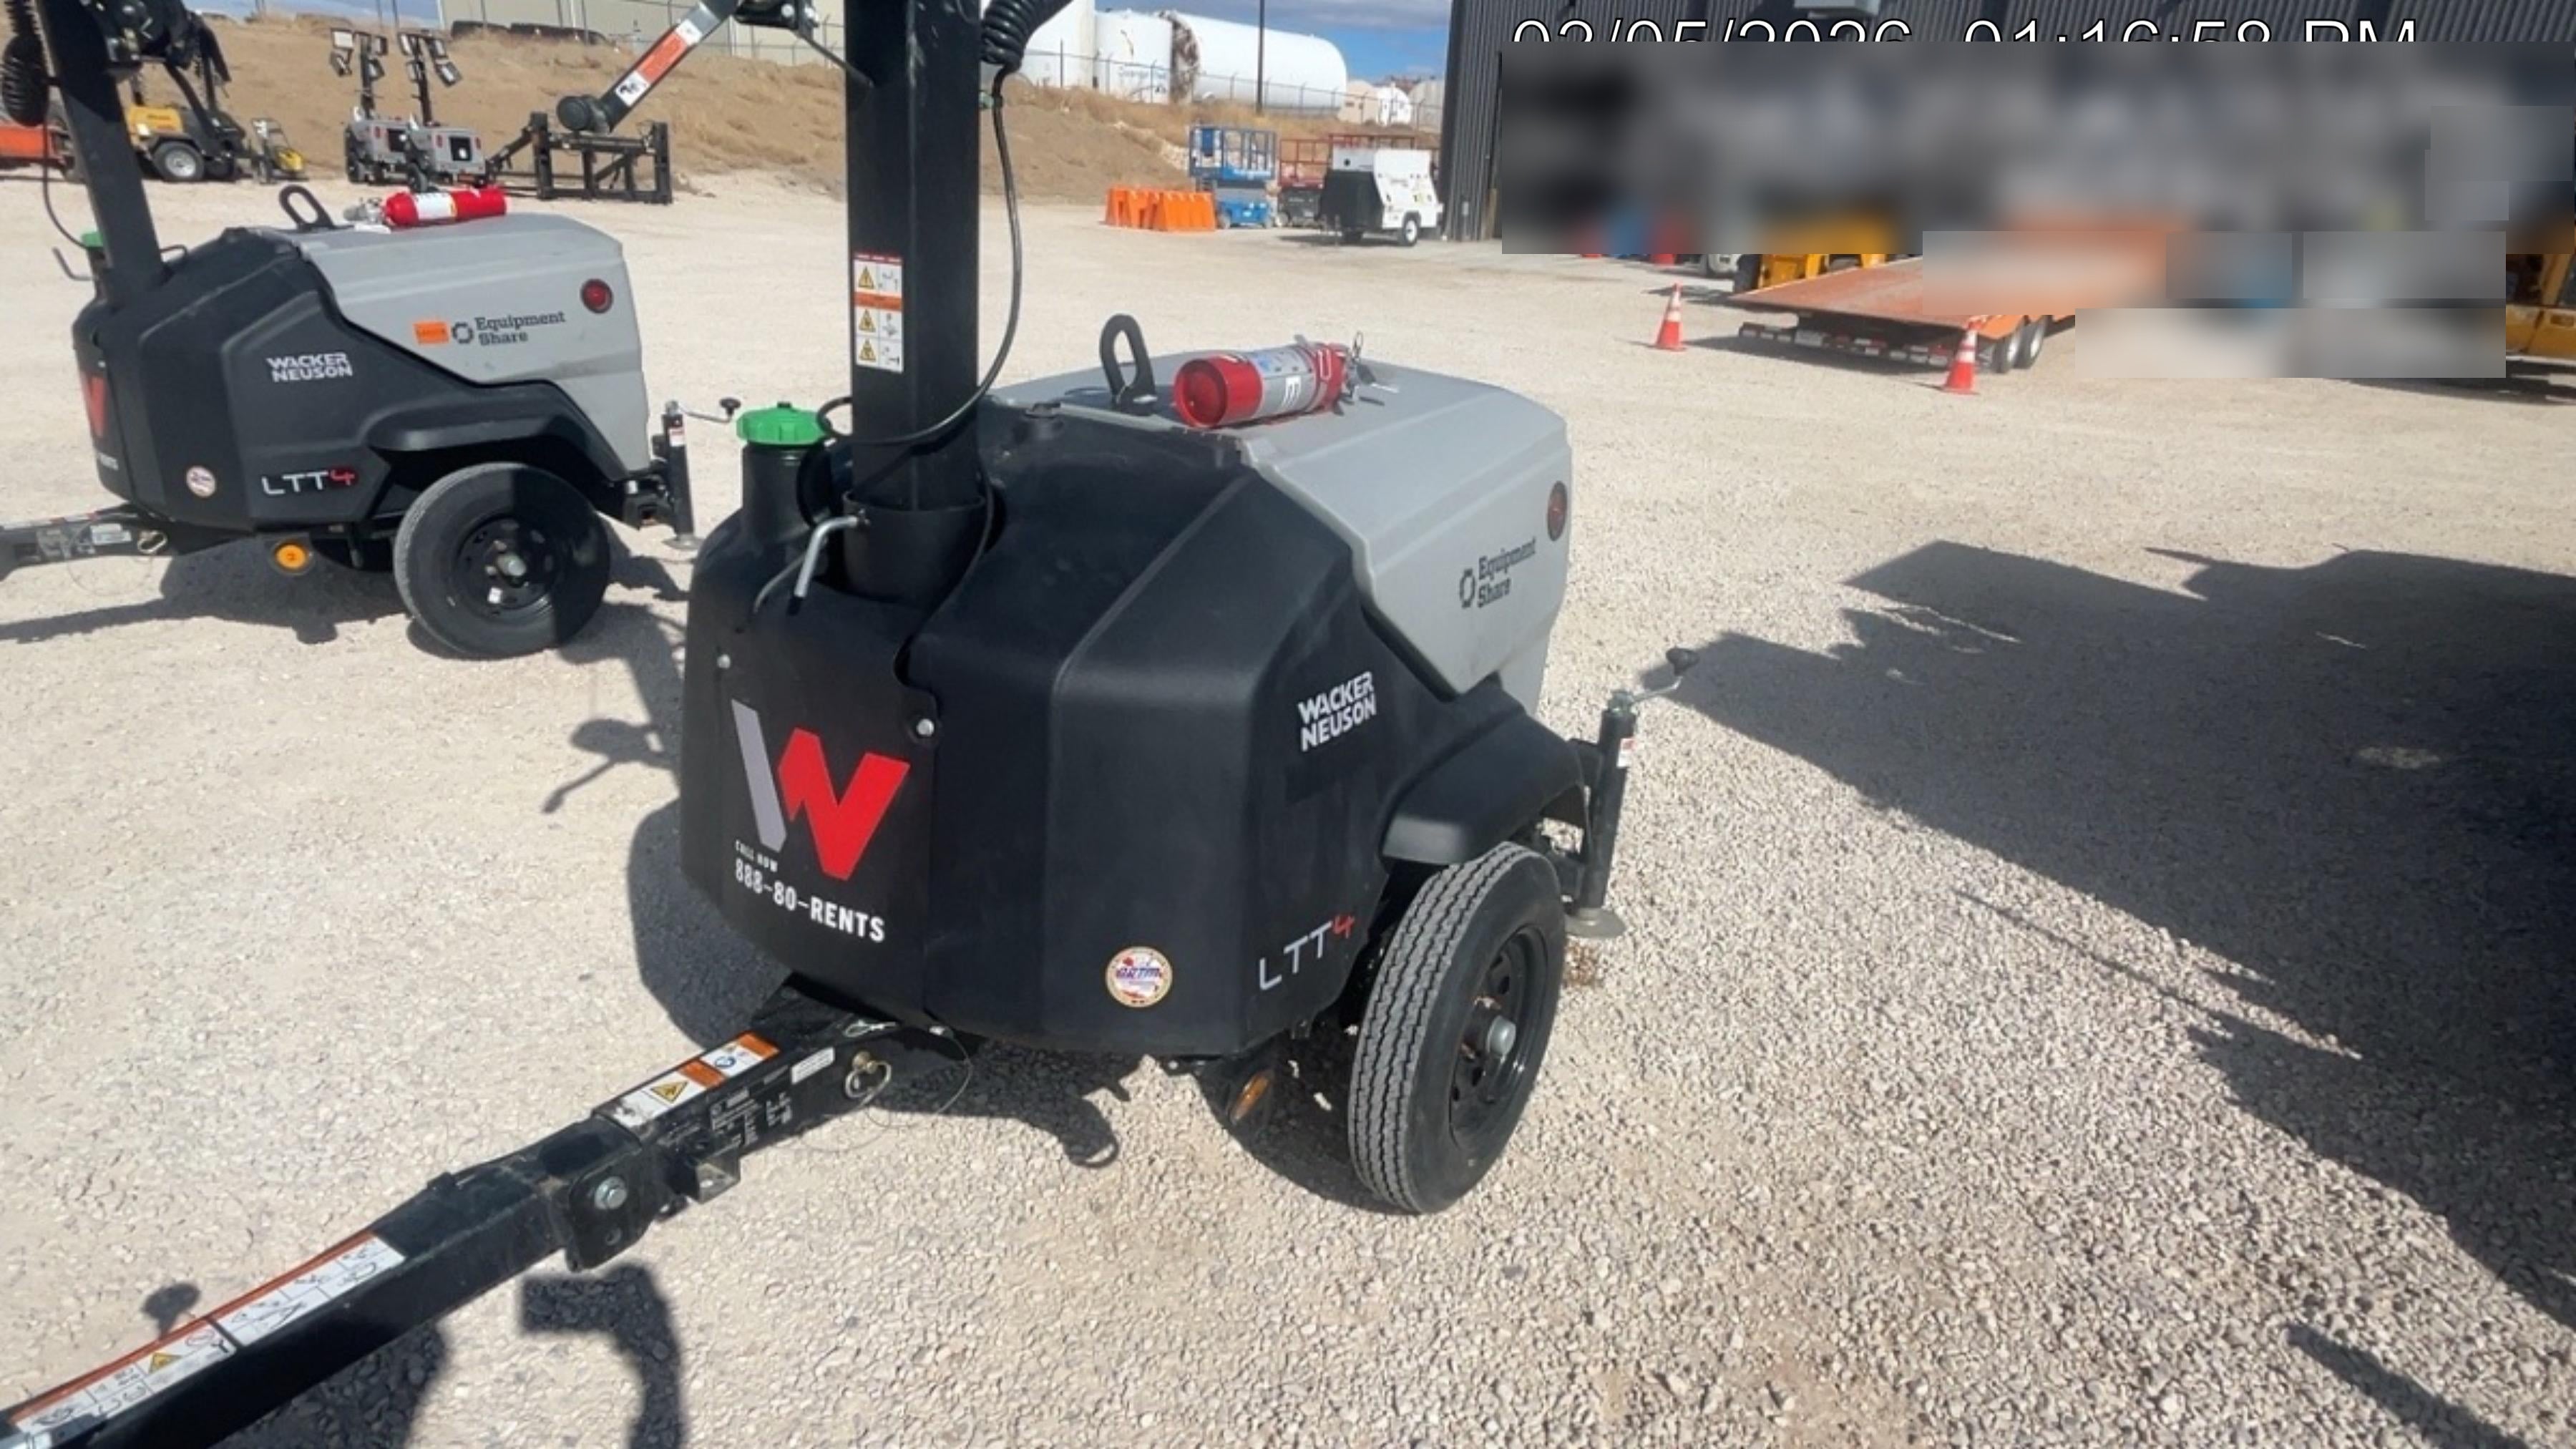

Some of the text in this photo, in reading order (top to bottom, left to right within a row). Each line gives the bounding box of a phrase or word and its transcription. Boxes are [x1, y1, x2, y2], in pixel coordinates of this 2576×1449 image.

[474, 311, 566, 331] Equipment
[478, 331, 528, 346] Share
[266, 352, 348, 369] WACKER
[272, 365, 353, 382] NEUSON
[261, 469, 355, 496] LTT4
[1478, 536, 1536, 581] Equipment
[1477, 577, 1511, 608] Share
[1297, 671, 1375, 724] WACKER
[1301, 693, 1377, 751] NEUSON
[735, 858, 885, 943] 888-80-RENTS
[1259, 915, 1355, 990] LTT4
